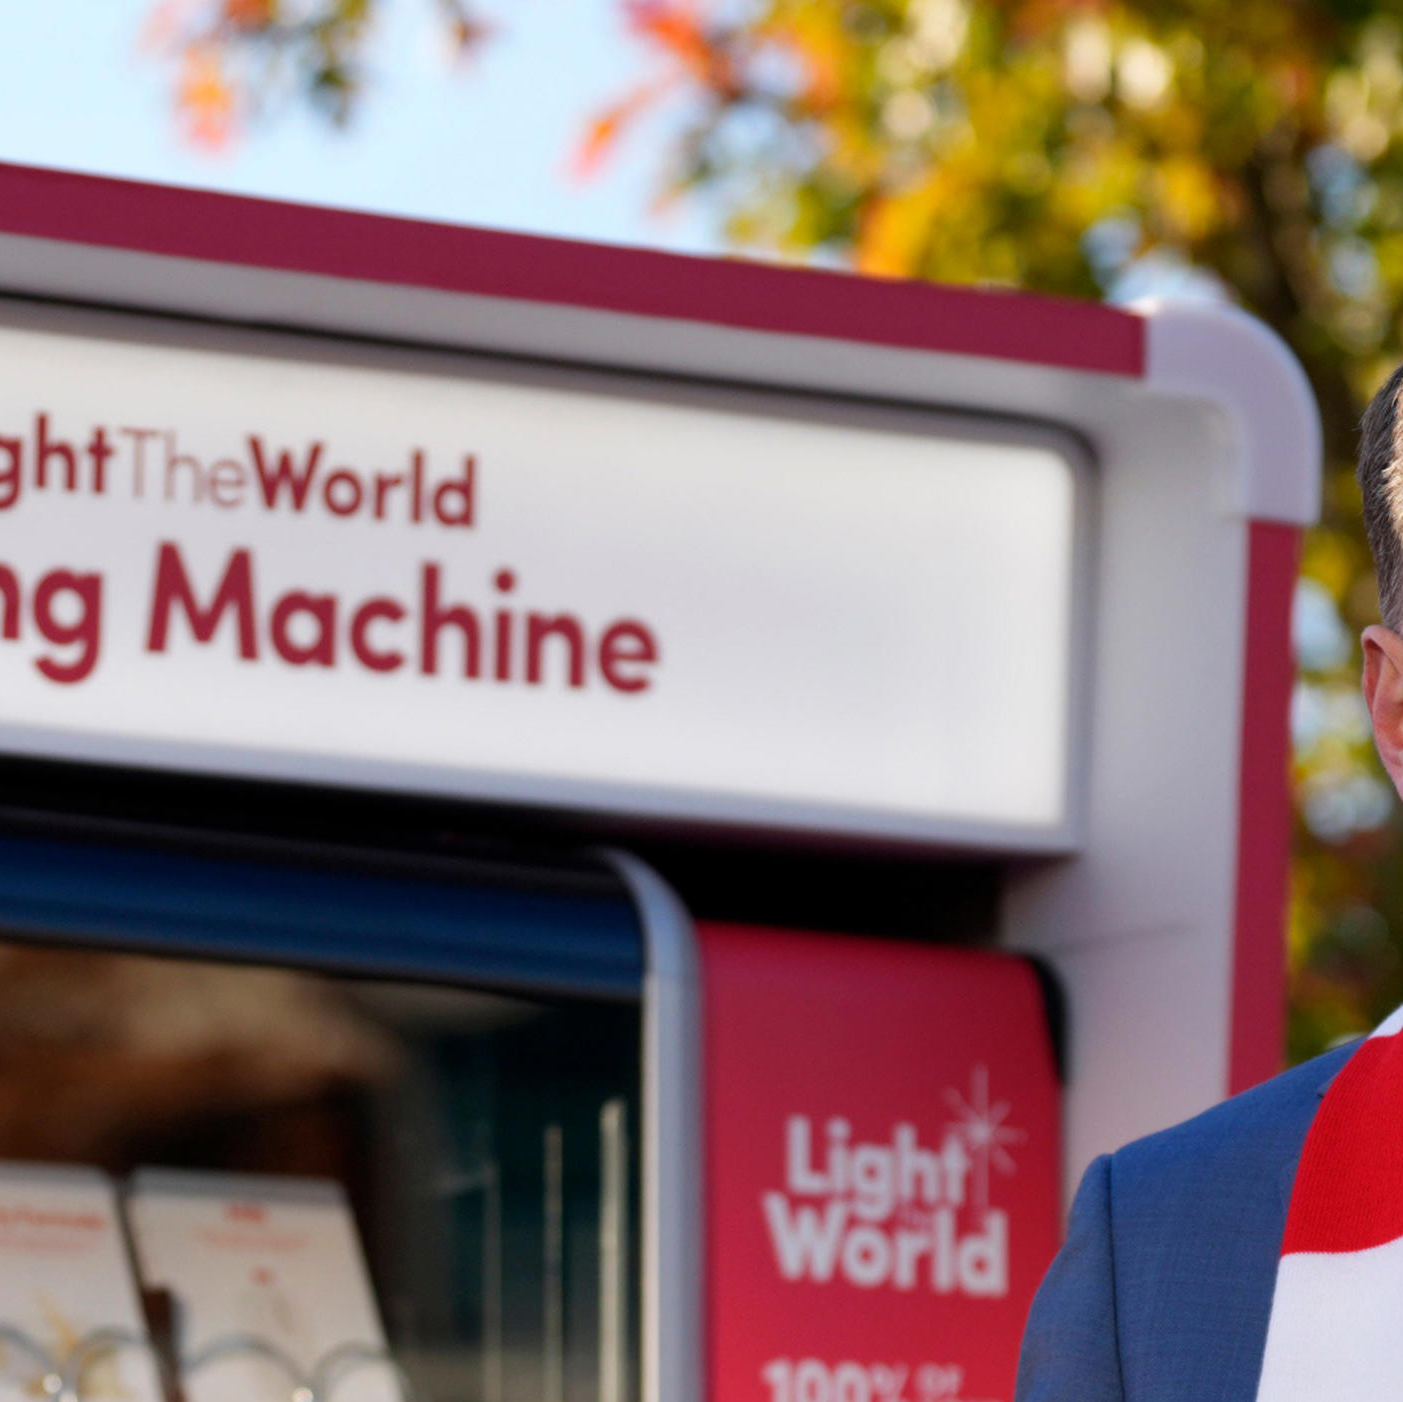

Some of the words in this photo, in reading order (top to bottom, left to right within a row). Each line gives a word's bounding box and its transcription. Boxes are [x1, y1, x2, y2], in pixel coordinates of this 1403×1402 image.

[144, 540, 660, 695] Machine
[786, 1114, 970, 1222] Light
[762, 1191, 1009, 1297] World
